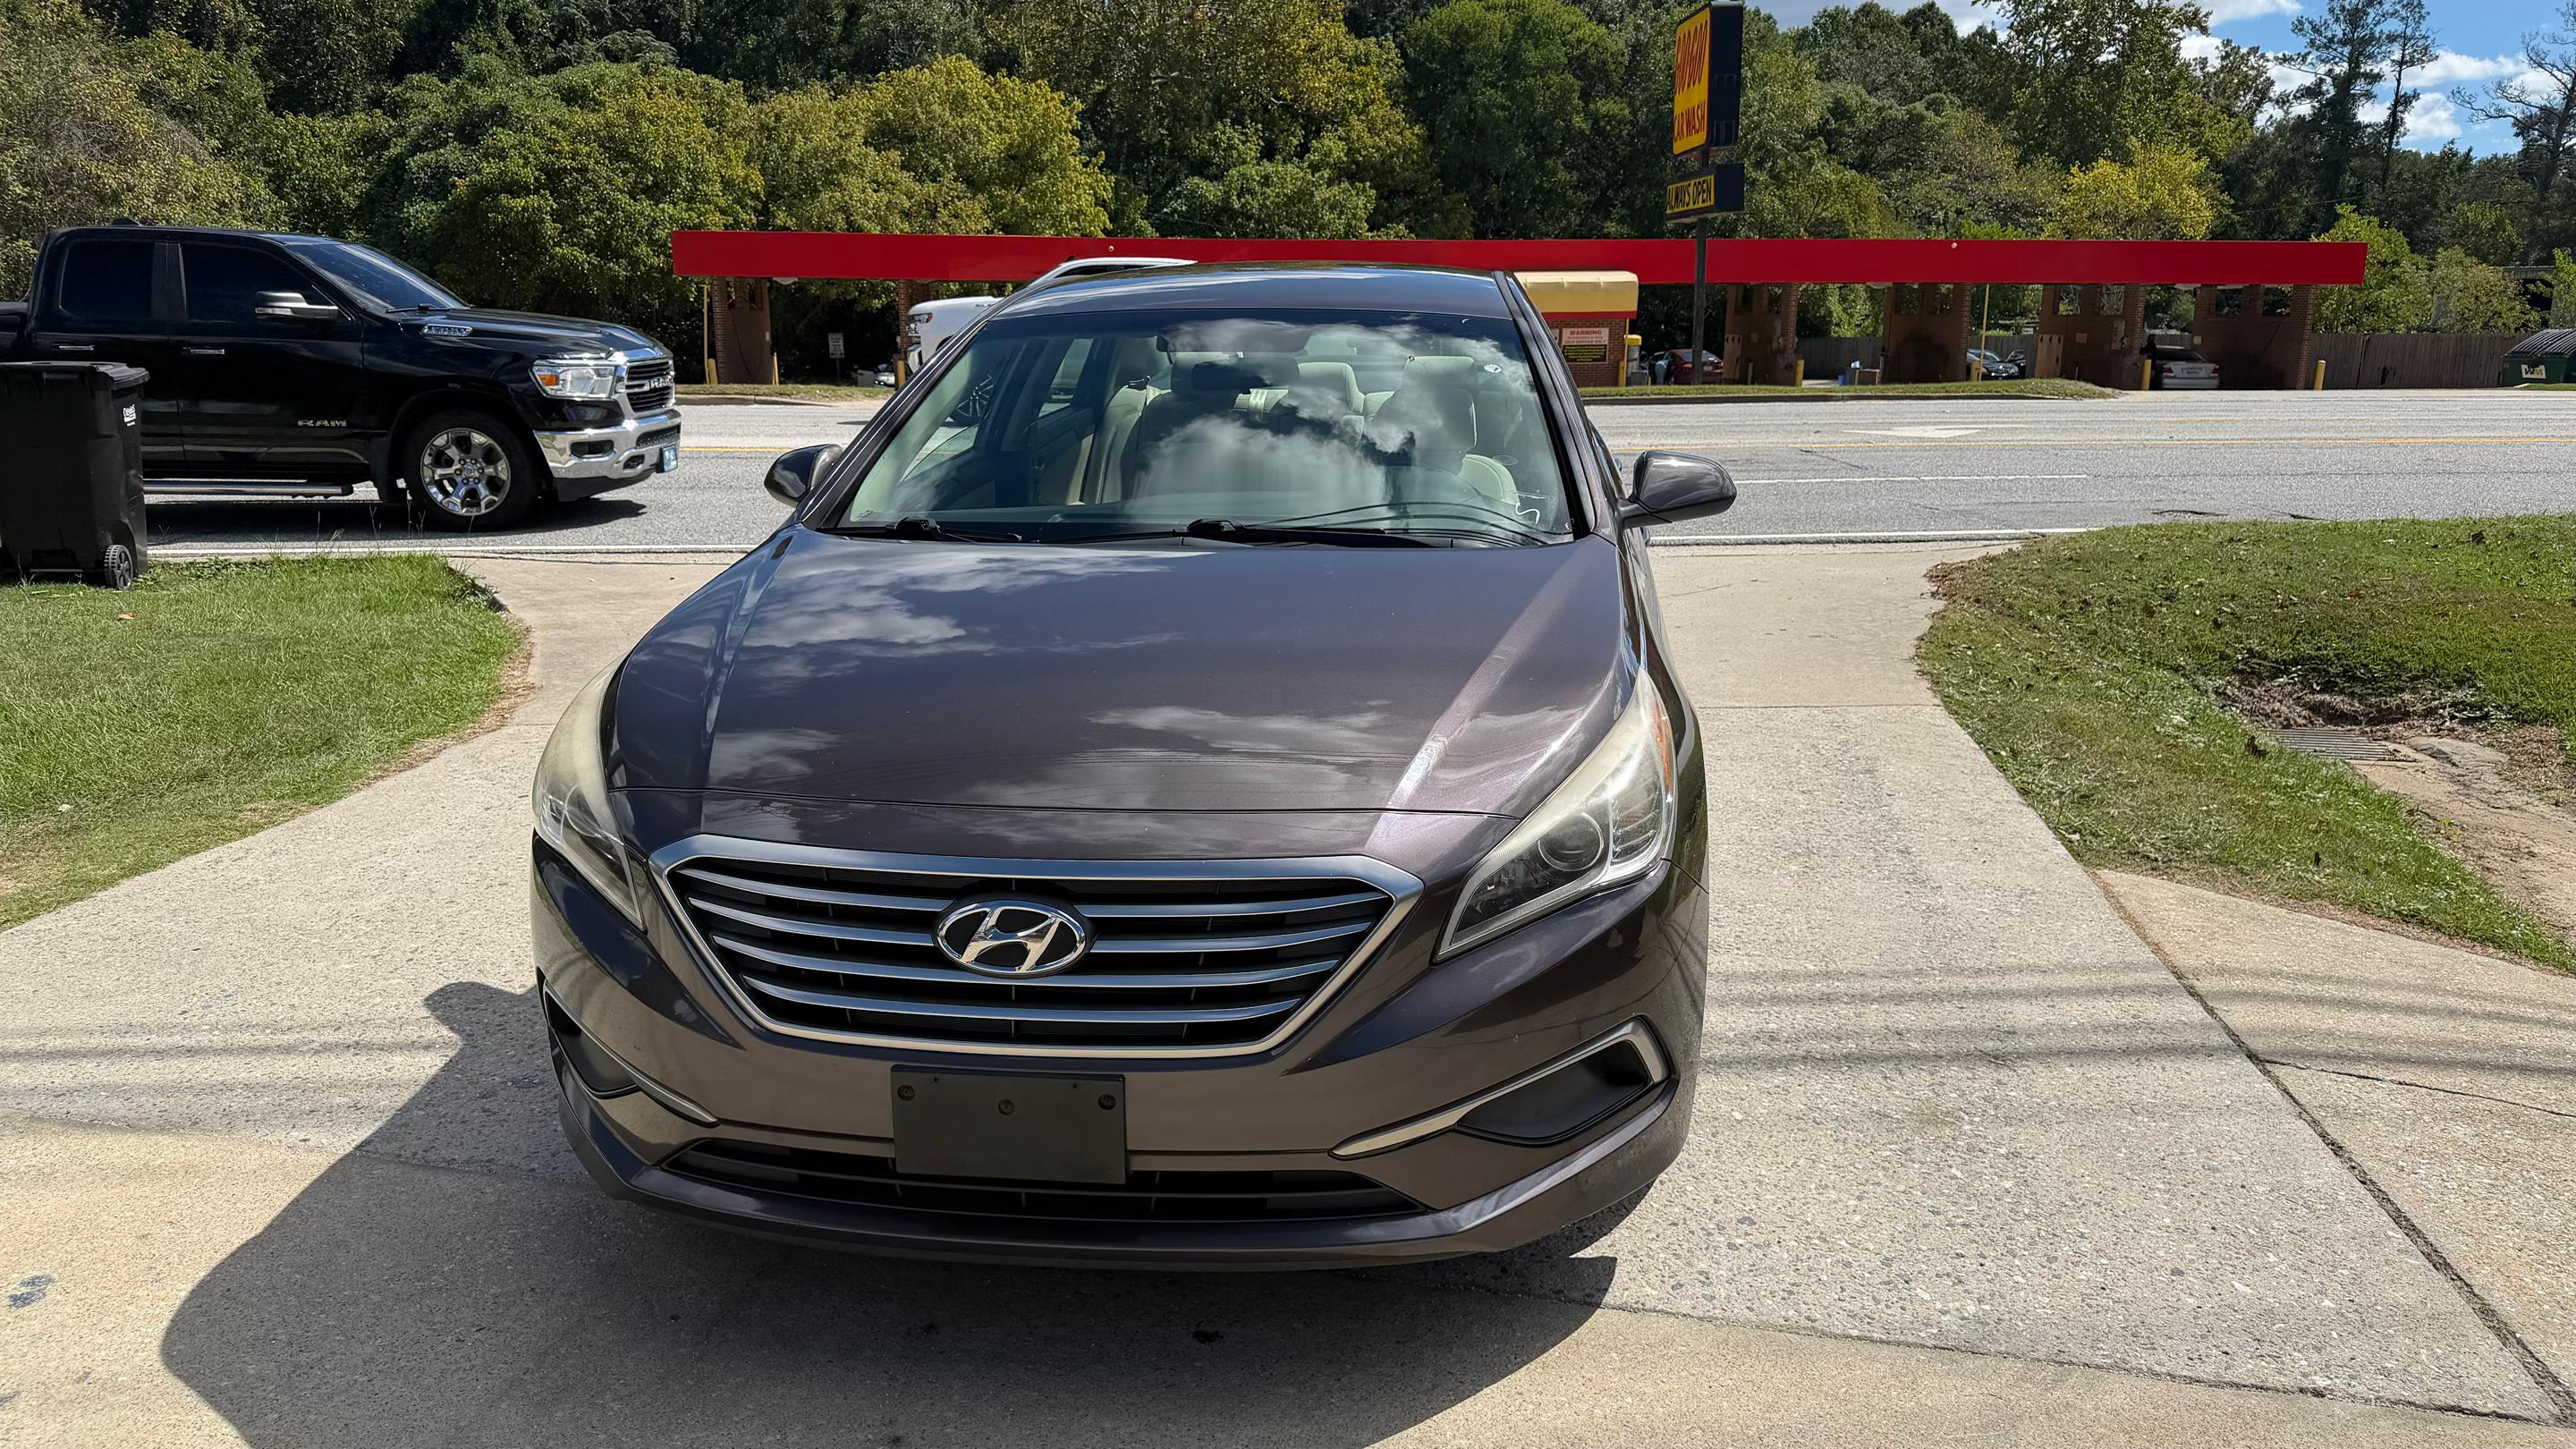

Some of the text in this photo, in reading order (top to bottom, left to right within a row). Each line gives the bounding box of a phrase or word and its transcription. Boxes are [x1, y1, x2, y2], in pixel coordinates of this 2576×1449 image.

[1674, 101, 1706, 143] CAR WASH
[1666, 177, 1712, 211] ALWAYS OPEN
